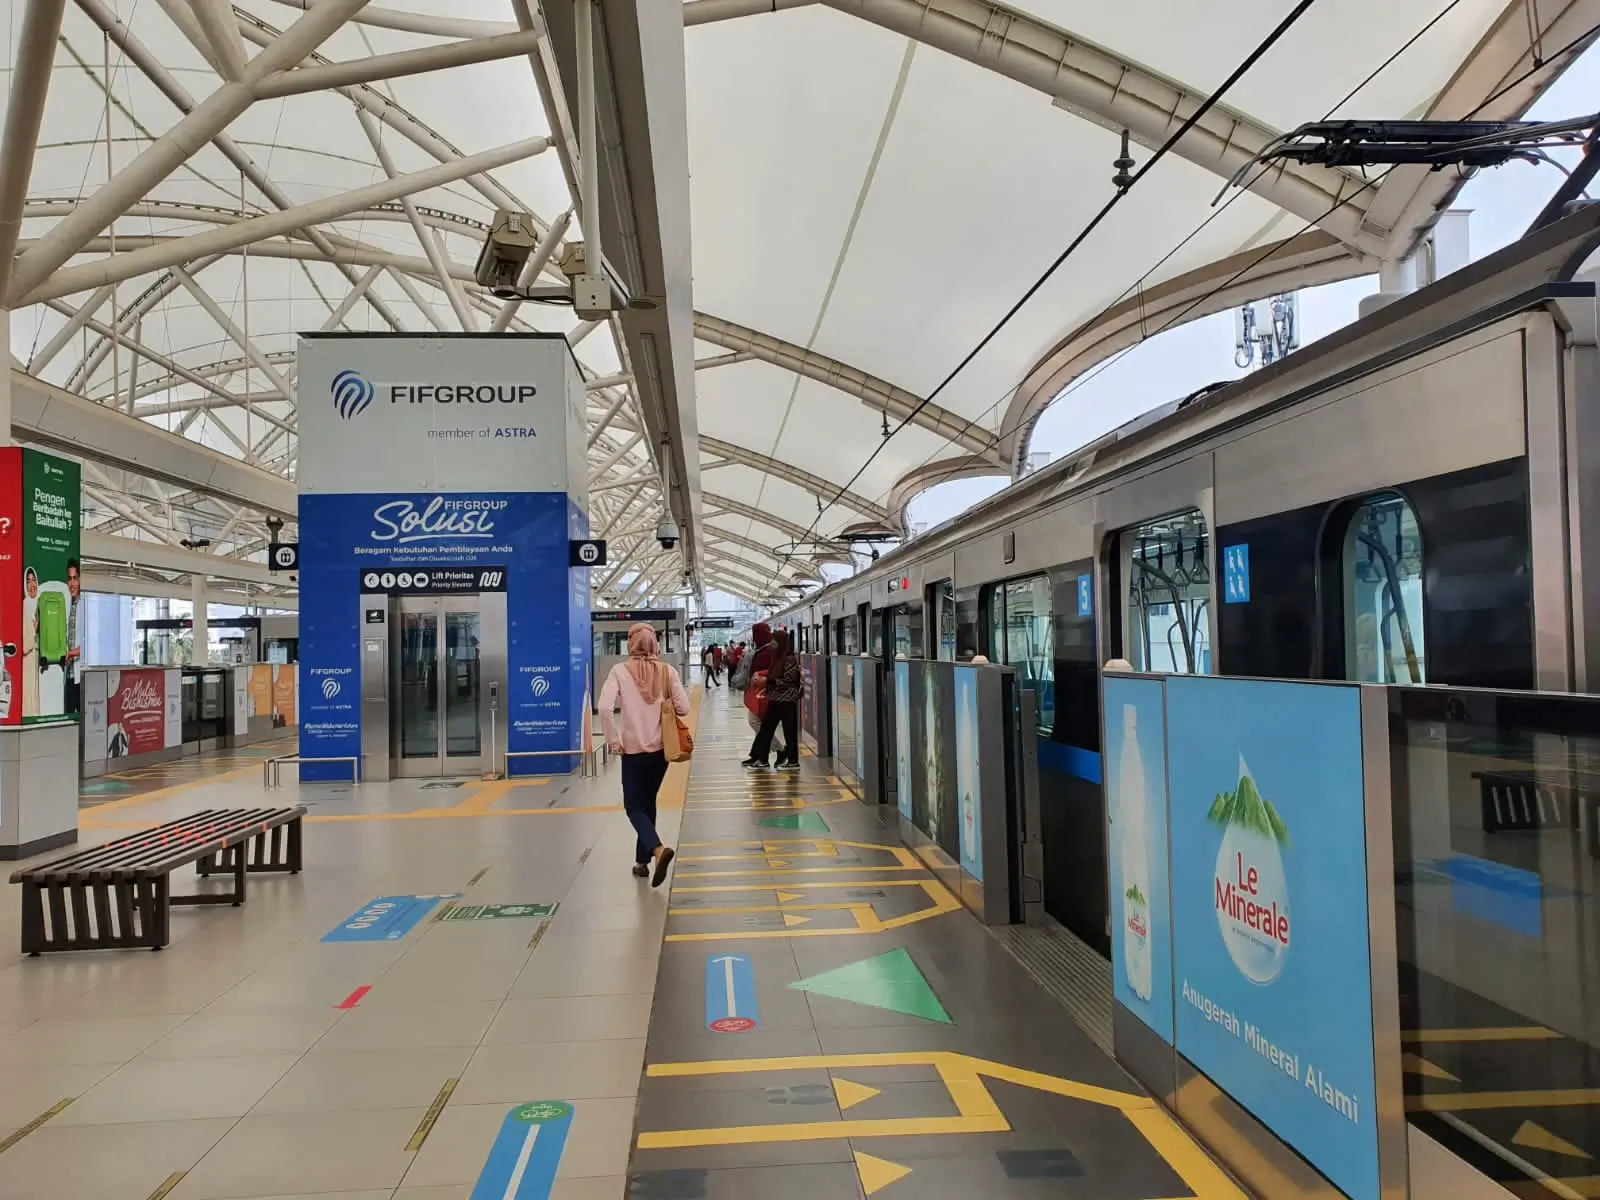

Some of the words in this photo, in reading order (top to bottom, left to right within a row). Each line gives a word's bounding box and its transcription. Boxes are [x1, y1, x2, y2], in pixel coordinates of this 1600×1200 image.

[391, 386, 537, 403] FIFGROUP
[428, 427, 475, 438] member
[479, 427, 490, 438] of
[494, 427, 537, 438] ASTRA
[34, 487, 65, 506] Pengen
[445, 500, 508, 511] FIFGROUP
[371, 496, 494, 540] Solusi
[354, 547, 392, 556] Beragam
[393, 546, 438, 554] Kebutuhan
[491, 544, 513, 553] Anda
[432, 572, 443, 580] Lift
[445, 571, 474, 580] Prioritas
[1238, 851, 1258, 895] Le
[1216, 877, 1288, 944] Minerale
[1182, 979, 1240, 1038] Anugerah
[1244, 1020, 1300, 1081] Mineral
[1305, 1063, 1359, 1124] Alami
